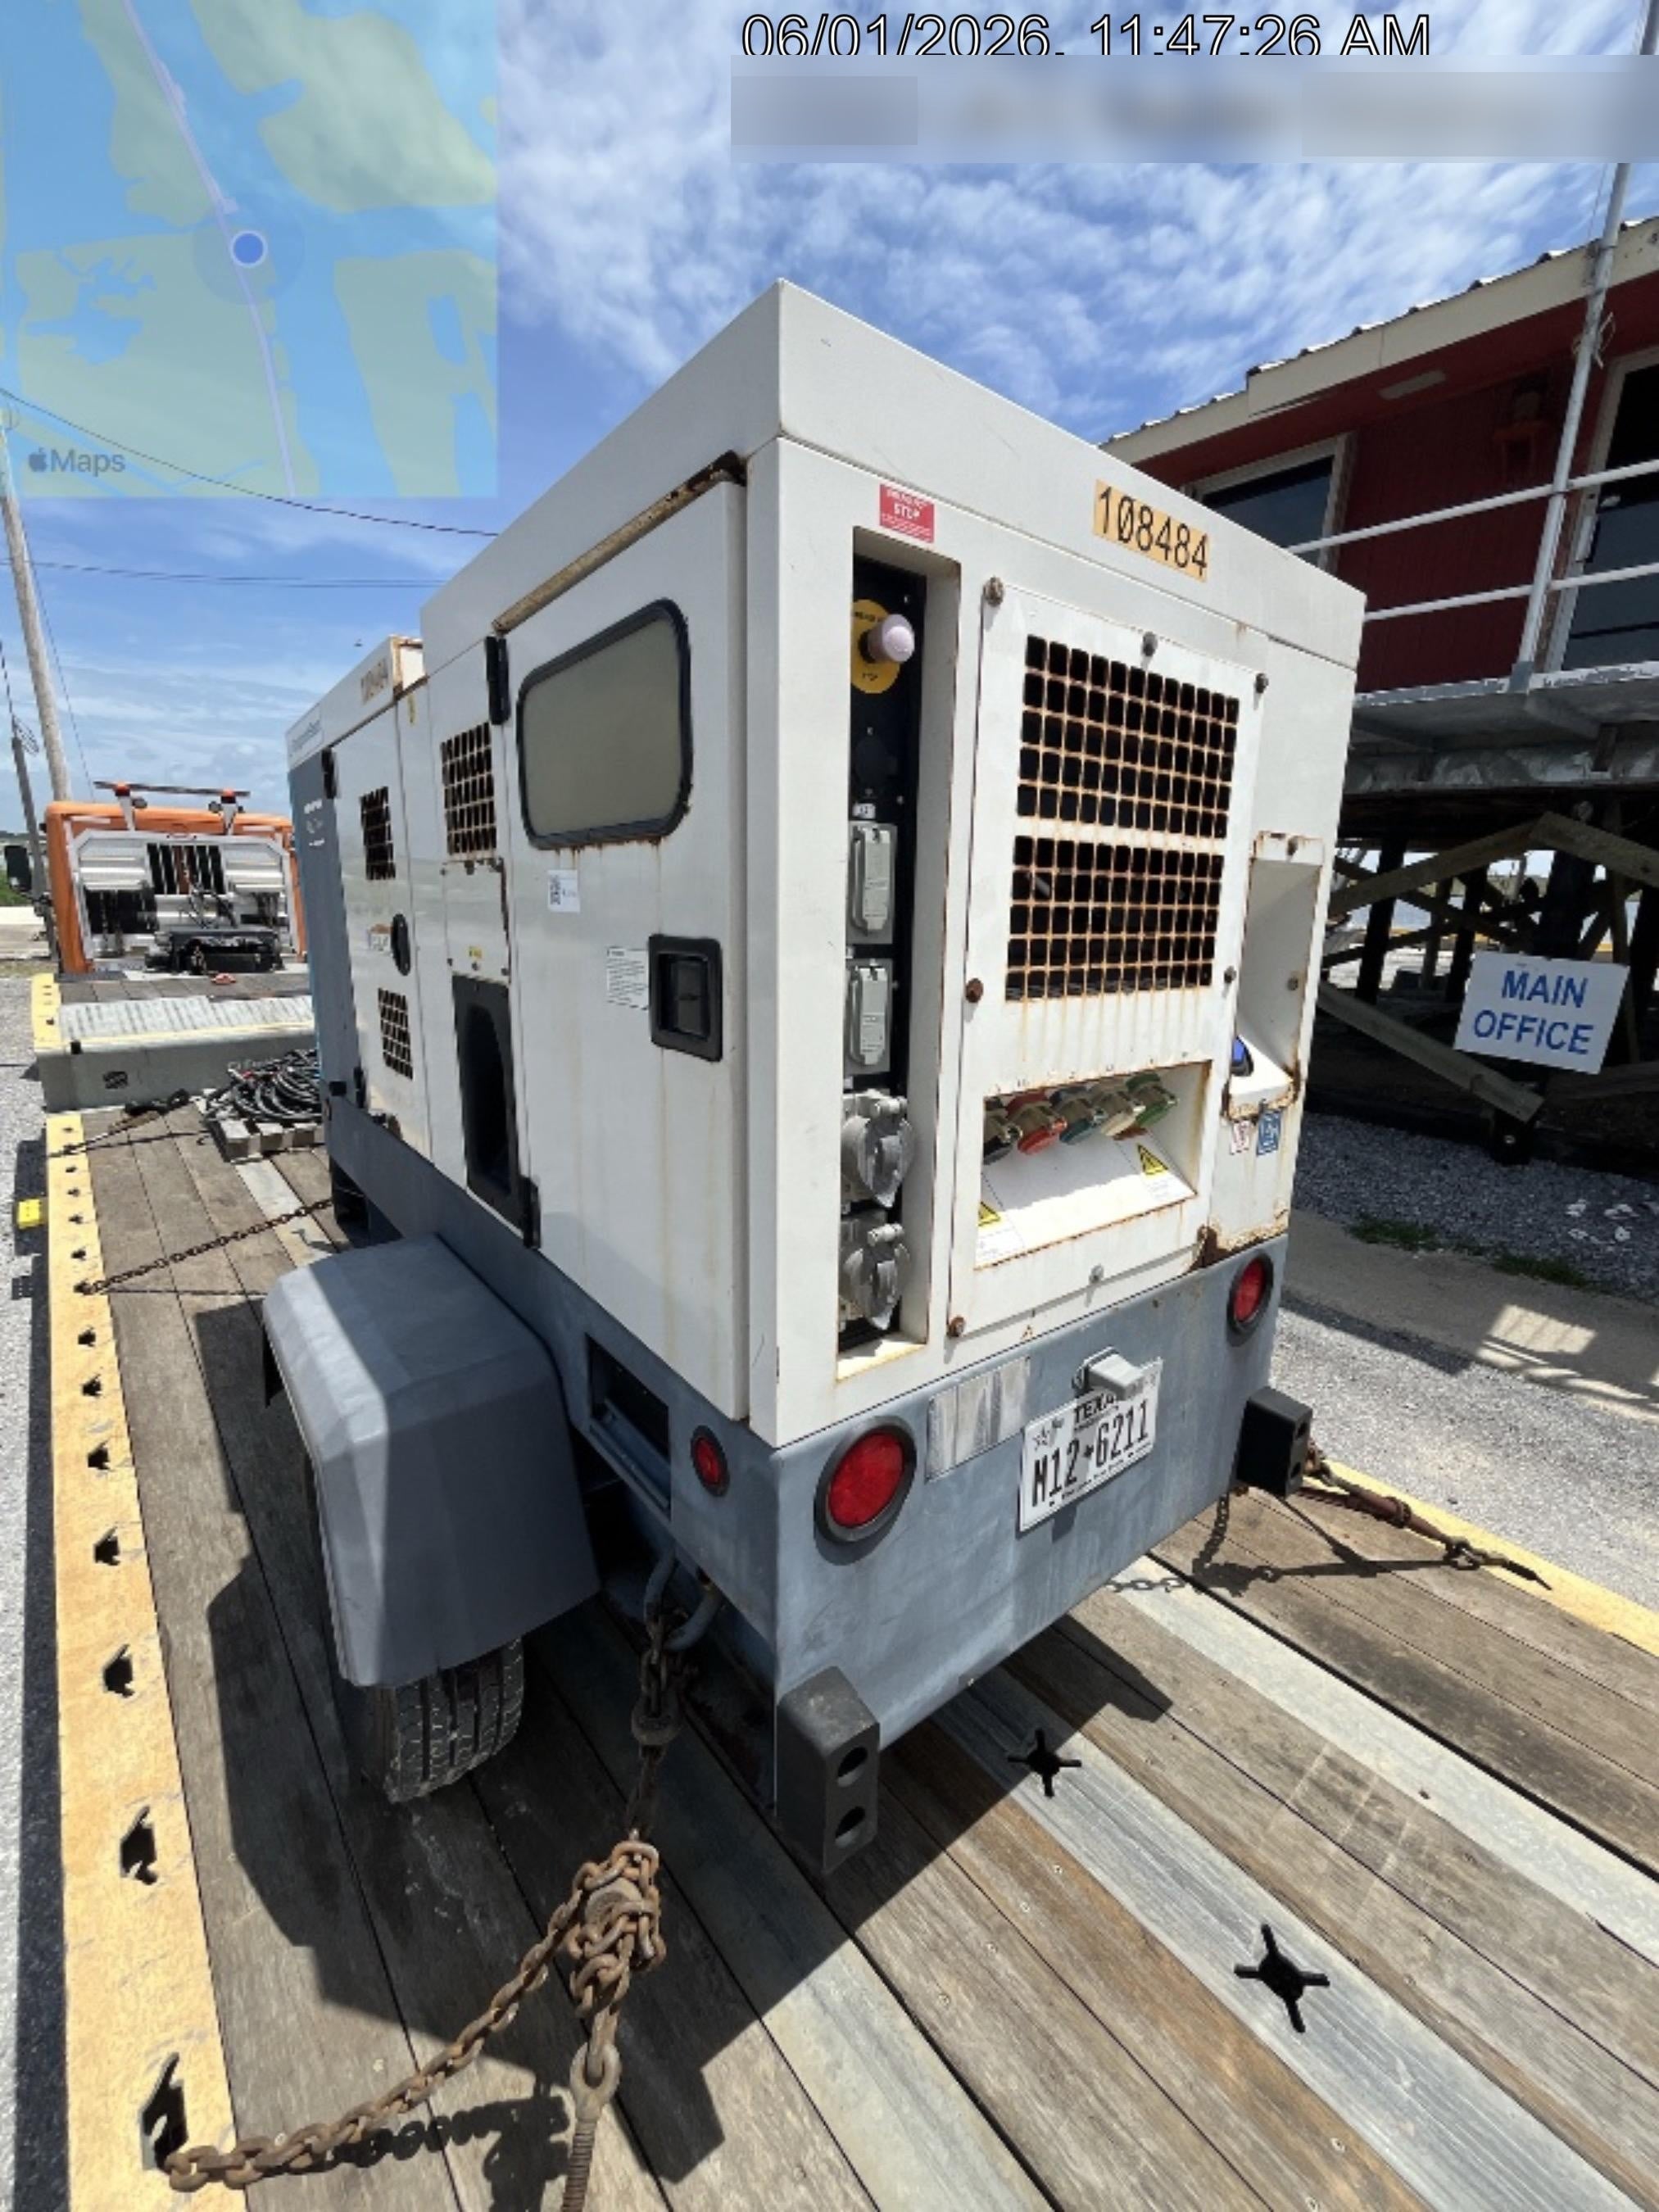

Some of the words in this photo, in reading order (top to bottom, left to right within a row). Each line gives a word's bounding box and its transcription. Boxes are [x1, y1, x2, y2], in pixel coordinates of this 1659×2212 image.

[1099, 486, 1208, 577] 108484
[1502, 970, 1589, 1009] MAIN
[1474, 1009, 1593, 1055] OFFICE
